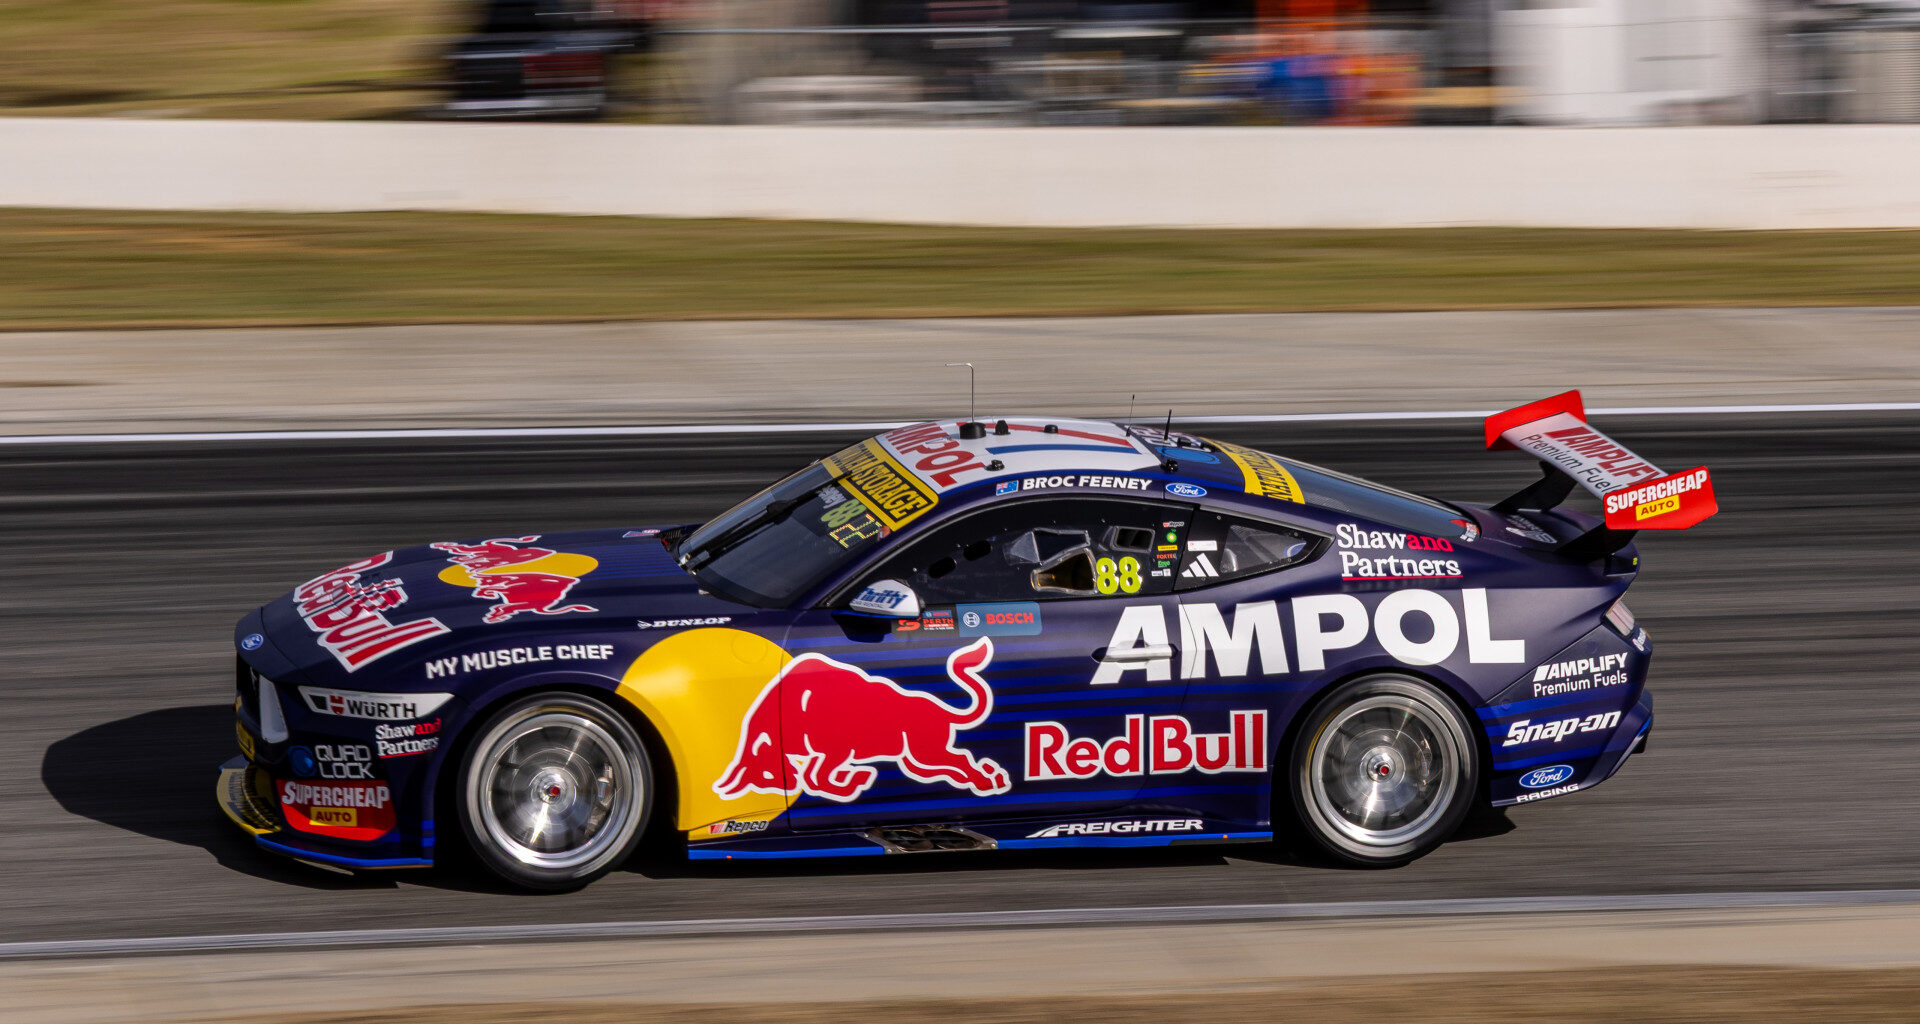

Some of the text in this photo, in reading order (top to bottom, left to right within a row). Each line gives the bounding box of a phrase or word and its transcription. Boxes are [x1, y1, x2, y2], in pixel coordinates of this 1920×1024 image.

[1519, 433, 1583, 470] Premium
[850, 462, 928, 519] STORAGE
[1023, 475, 1152, 491] BROC FEENEY
[1606, 469, 1708, 514] SUPERCHEAP
[821, 499, 866, 528] 88
[1640, 500, 1676, 516] AUTO
[1096, 556, 1142, 595] 88
[1339, 551, 1462, 577] Partners
[651, 616, 732, 628] DUNLOP
[986, 612, 1034, 624] BOSCH
[1090, 588, 1525, 685] AMPOL
[425, 644, 613, 679] MY MUSCLE CHEF
[1544, 652, 1628, 681] AMPLIFY
[1533, 670, 1628, 698] Premium Fuels
[1502, 711, 1622, 747] Snap-on
[315, 744, 372, 762] QUAD
[376, 736, 440, 757] Partners
[319, 762, 375, 779] LOCK
[281, 780, 390, 809] SUPERCHEAP
[1516, 783, 1580, 803] RACING
[315, 811, 353, 823] AUTO
[724, 820, 769, 834] Repco
[1034, 819, 1204, 838] FREIGHTER
